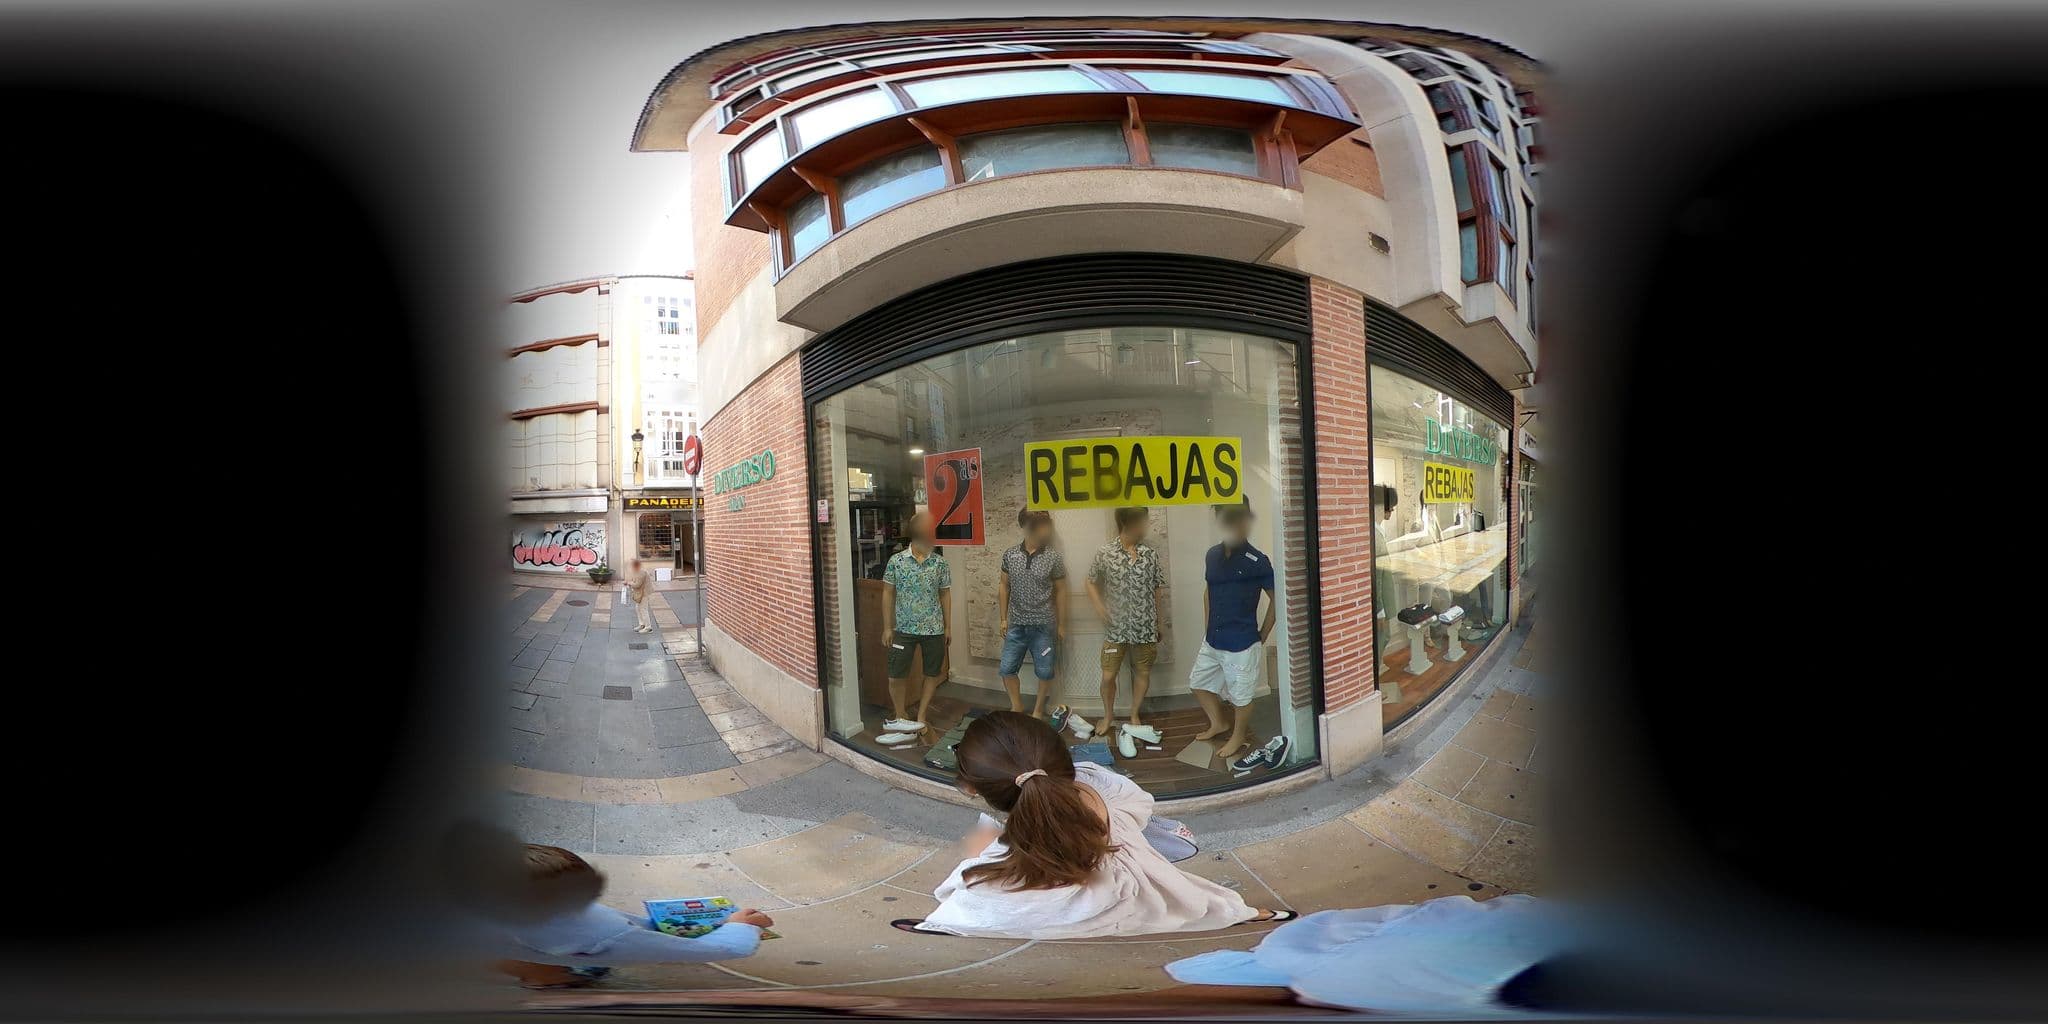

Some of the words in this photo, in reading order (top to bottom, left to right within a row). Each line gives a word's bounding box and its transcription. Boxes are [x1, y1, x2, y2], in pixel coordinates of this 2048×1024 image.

[1424, 416, 1498, 466] DIVERSO
[714, 449, 775, 495] DIVERSO
[1030, 442, 1239, 504] REBAJAS
[1425, 465, 1475, 499] REBAJAS
